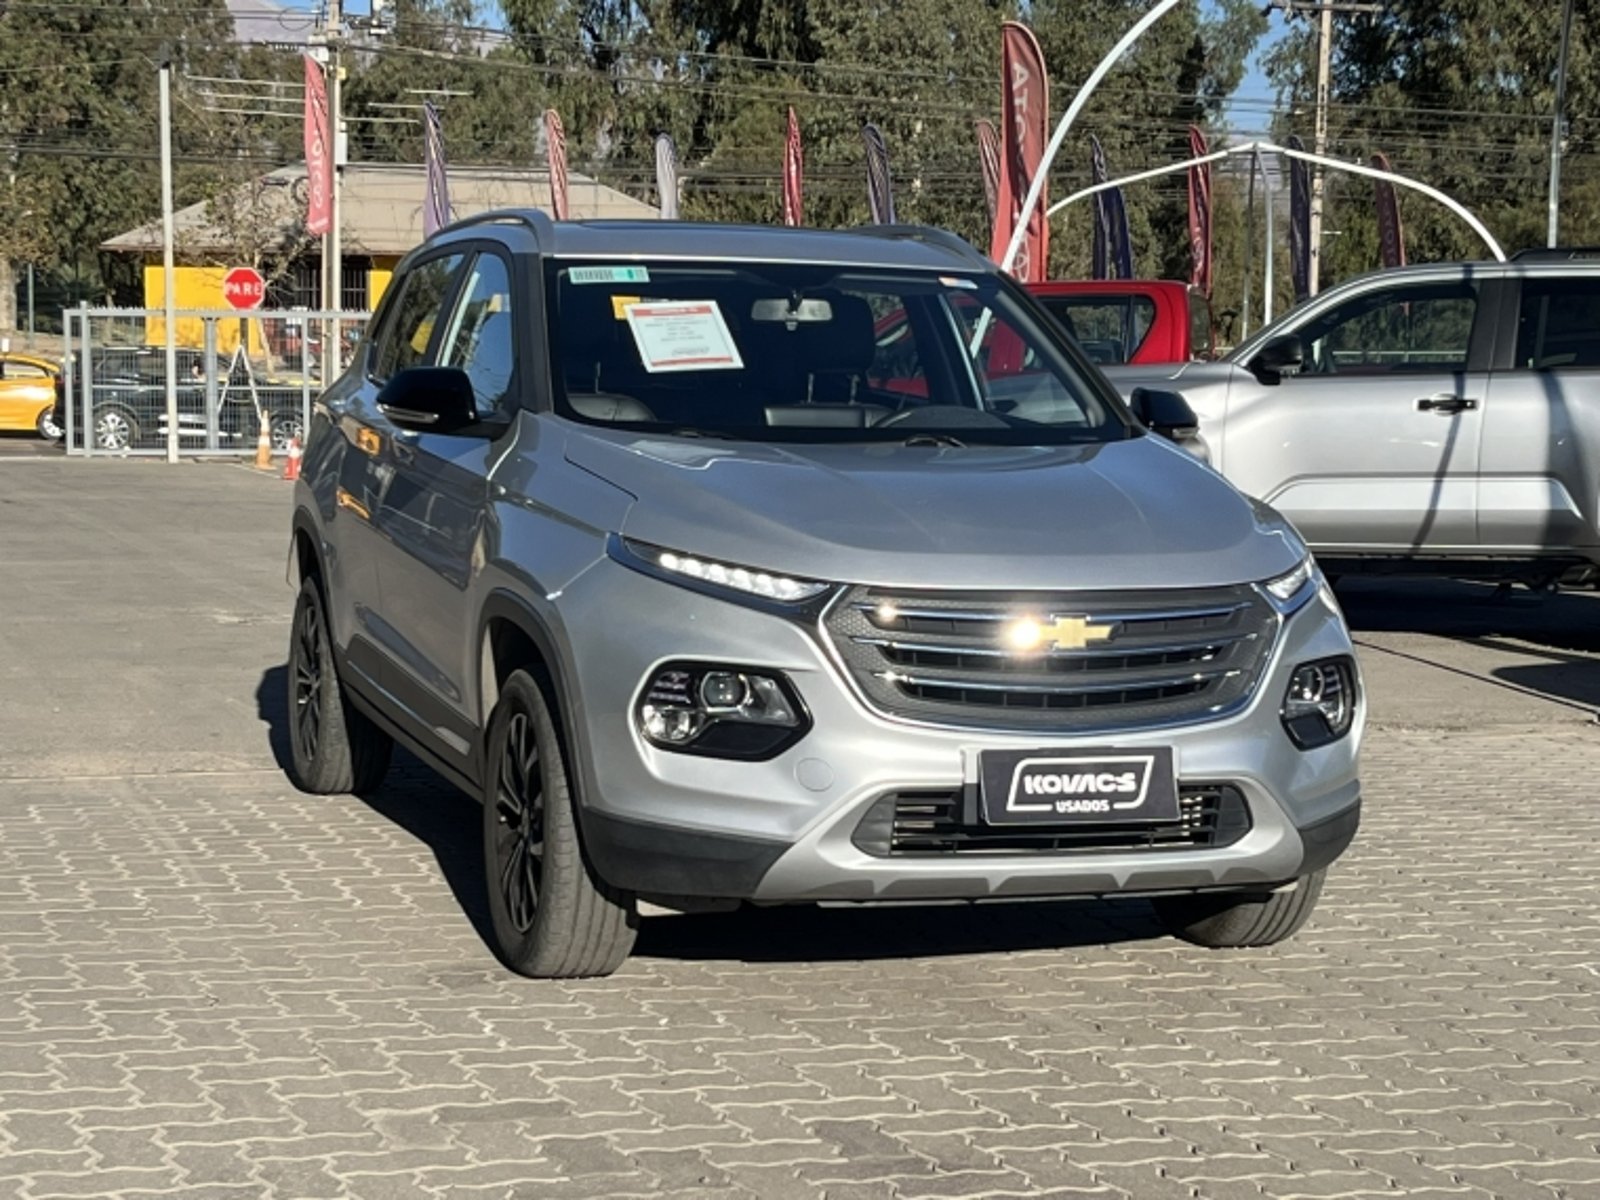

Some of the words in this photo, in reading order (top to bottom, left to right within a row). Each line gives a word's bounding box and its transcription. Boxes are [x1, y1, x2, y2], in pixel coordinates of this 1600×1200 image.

[225, 281, 262, 296] PARE
[1023, 772, 1137, 795] KOVACS
[1055, 800, 1110, 813] USADOS
